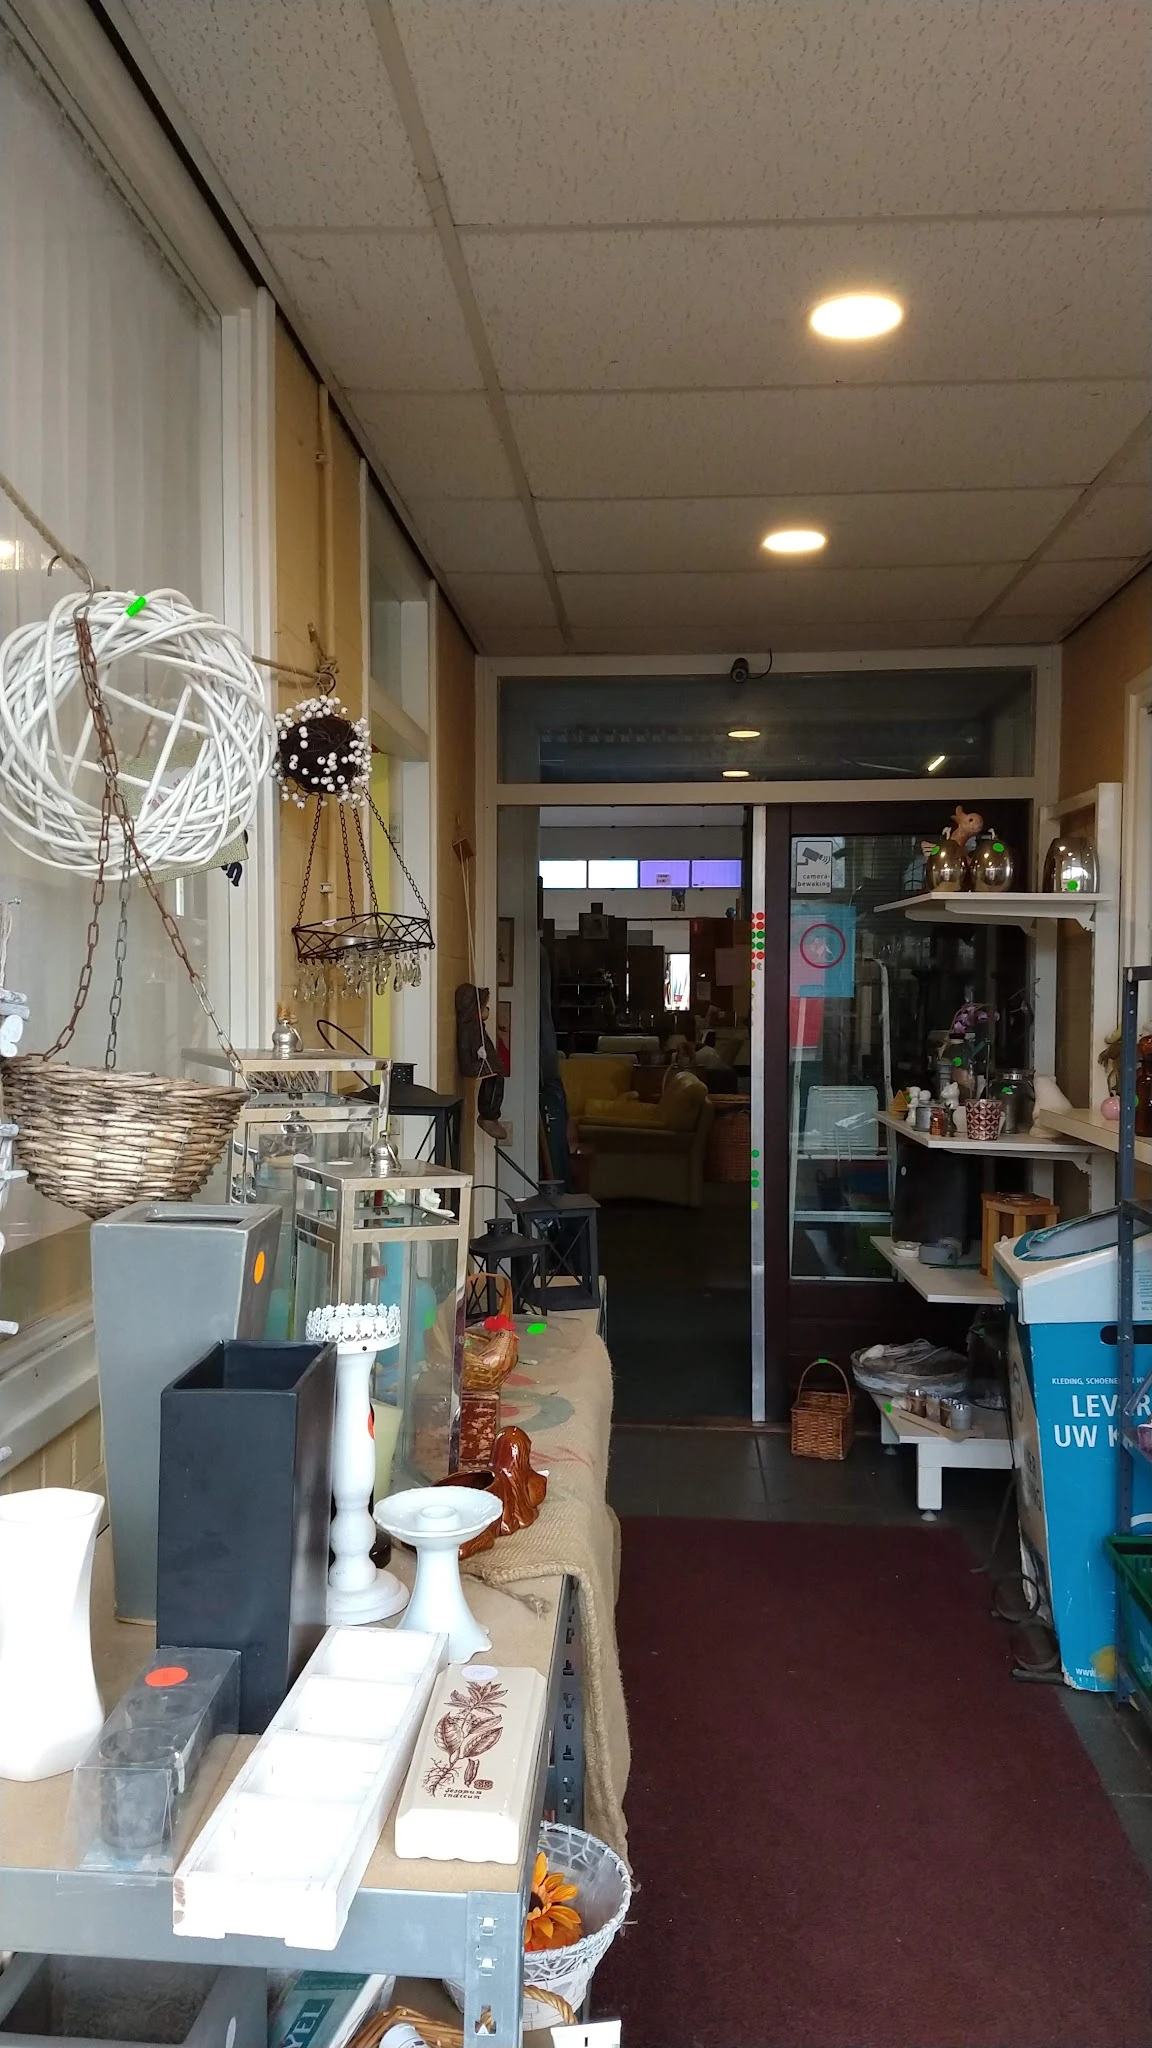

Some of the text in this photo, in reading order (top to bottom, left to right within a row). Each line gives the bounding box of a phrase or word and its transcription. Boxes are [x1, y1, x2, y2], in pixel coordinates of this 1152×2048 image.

[1086, 1377, 1119, 1385] SCHOENE
[1072, 1394, 1152, 1418] LEVR
[1054, 1424, 1098, 1448] UW
[445, 1787, 482, 1795] Sesamum
